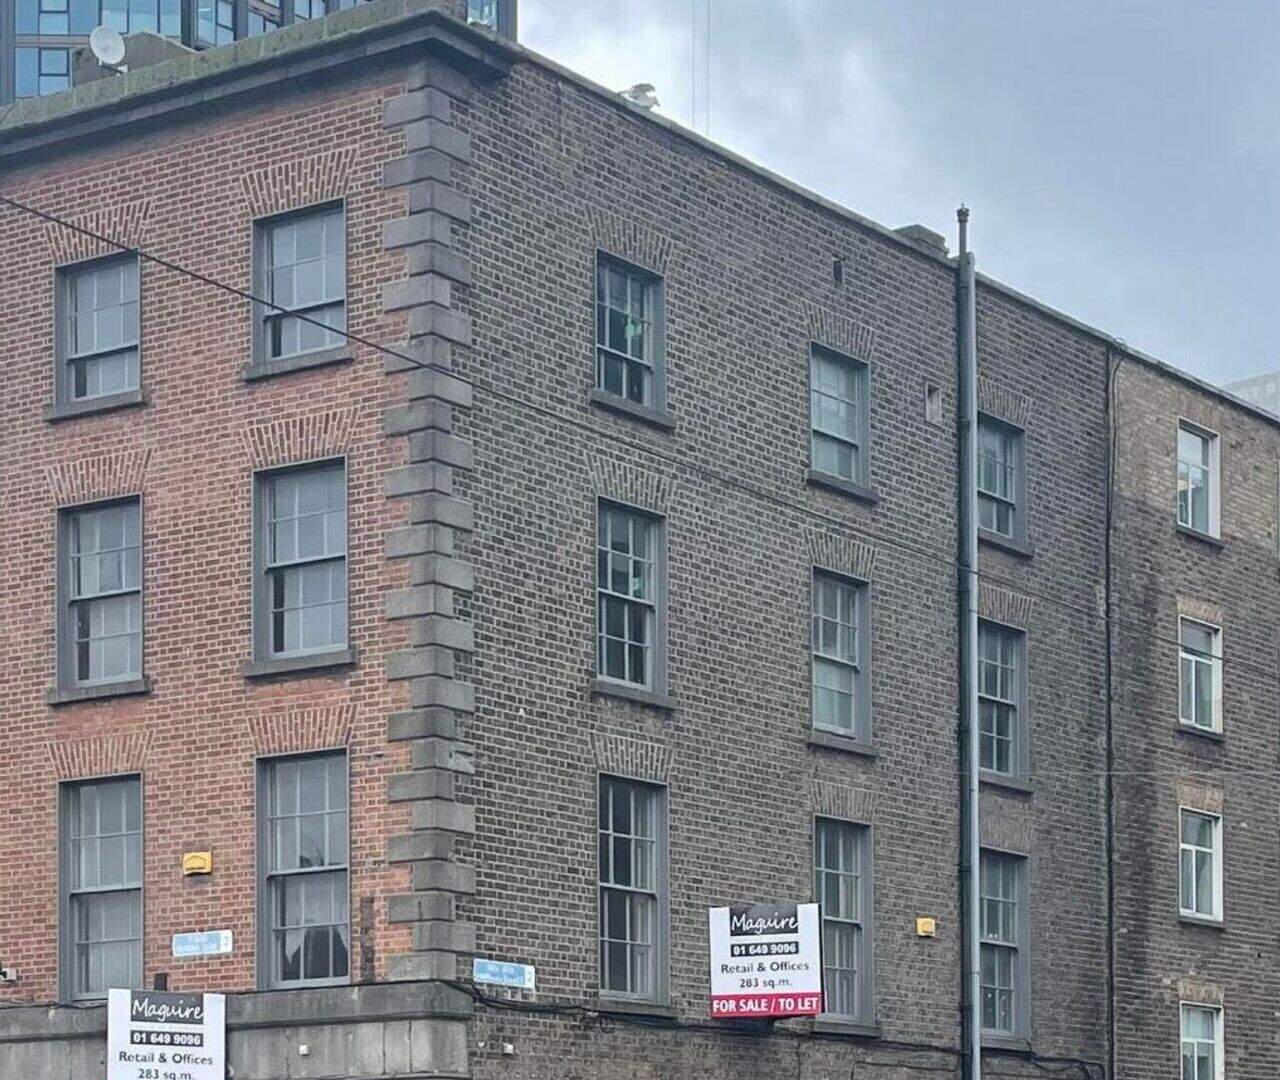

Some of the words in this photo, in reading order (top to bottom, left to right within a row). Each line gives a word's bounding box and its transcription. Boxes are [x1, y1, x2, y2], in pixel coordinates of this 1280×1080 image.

[731, 913, 801, 935] Maguire
[733, 945, 746, 955] 01
[749, 945, 768, 955] 649
[771, 943, 797, 954] 9096
[721, 963, 754, 974] Retail
[757, 962, 766, 972] &
[770, 961, 810, 972] Offices
[740, 978, 759, 988] 283
[132, 998, 206, 1021] Maguire
[713, 1000, 736, 1013] FOR
[739, 999, 768, 1012] SALE
[778, 999, 795, 1011] TO
[798, 997, 819, 1010] LET
[133, 1032, 147, 1043] 01
[150, 1034, 171, 1045] 649
[173, 1035, 201, 1046] 9096
[119, 1051, 155, 1063] Retail
[158, 1053, 167, 1063] &
[172, 1053, 213, 1065] Offices
[138, 1069, 160, 1079] 283
